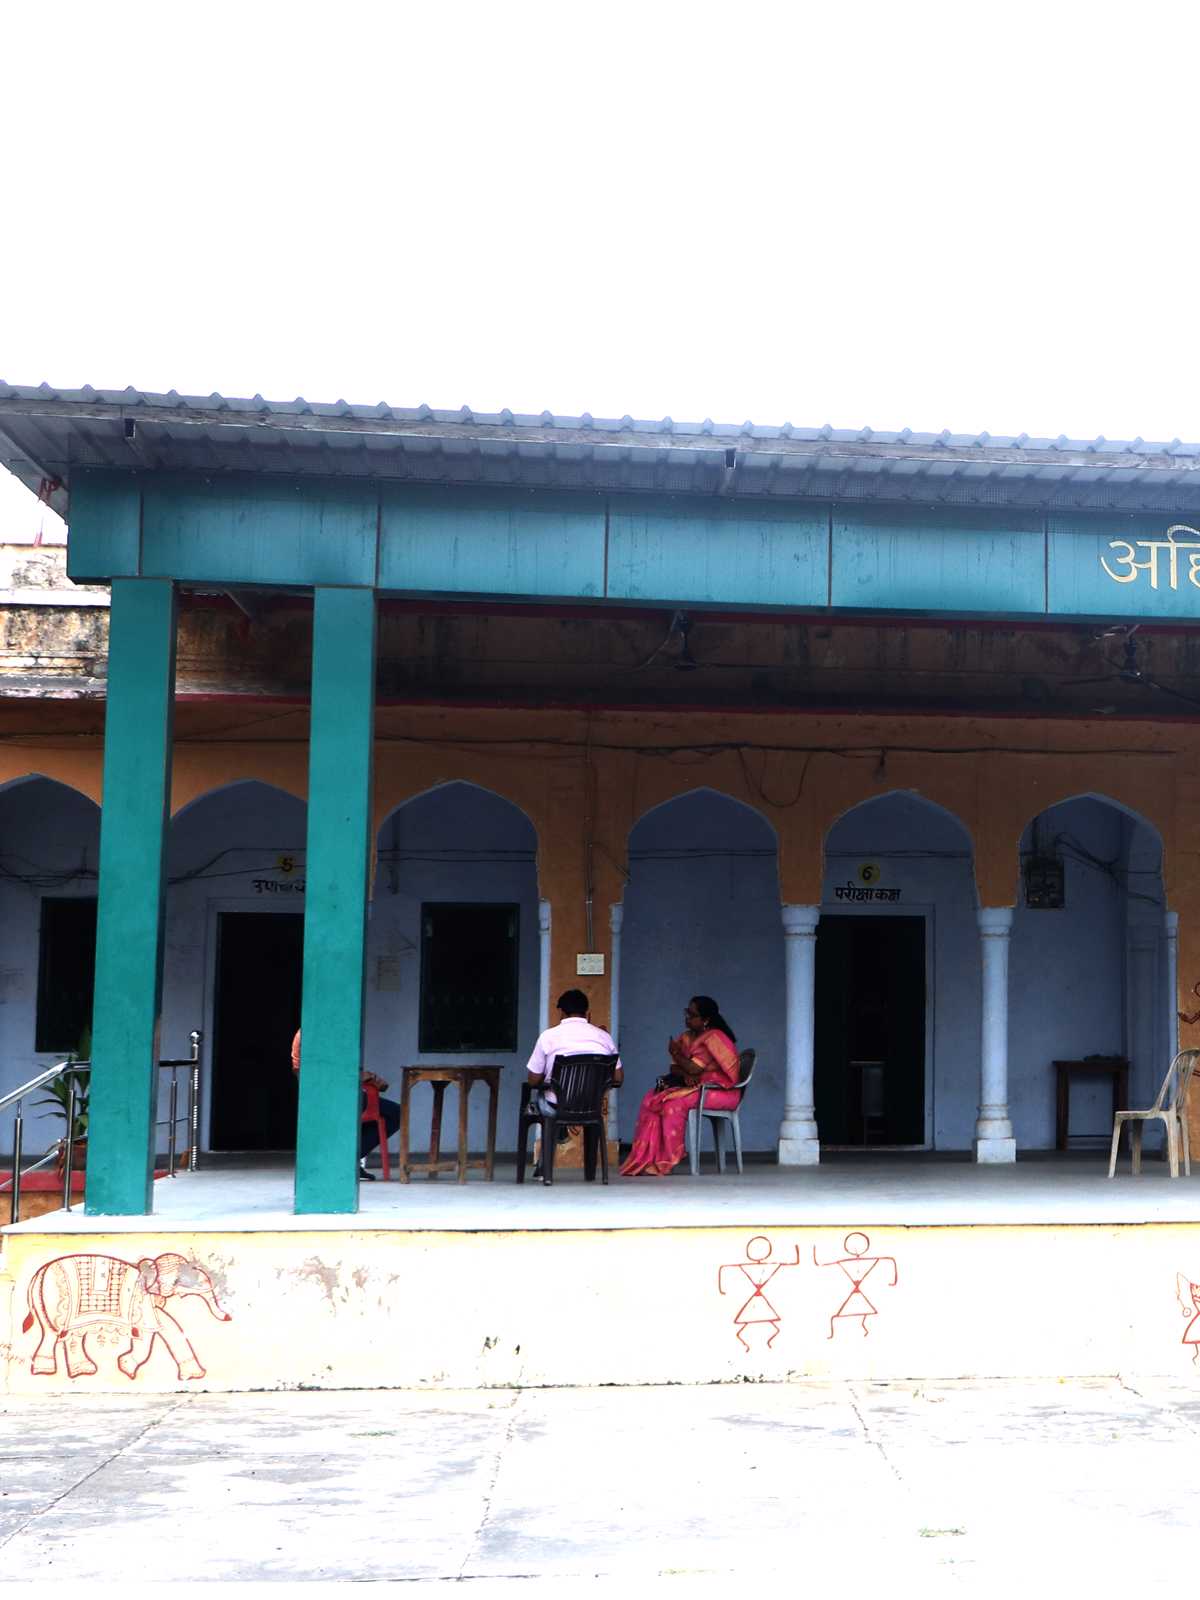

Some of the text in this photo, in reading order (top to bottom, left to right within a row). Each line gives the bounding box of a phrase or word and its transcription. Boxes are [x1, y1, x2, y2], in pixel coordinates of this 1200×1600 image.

[280, 857, 294, 873] 5
[861, 865, 874, 881] 6
[834, 880, 875, 904] परीक्षा
